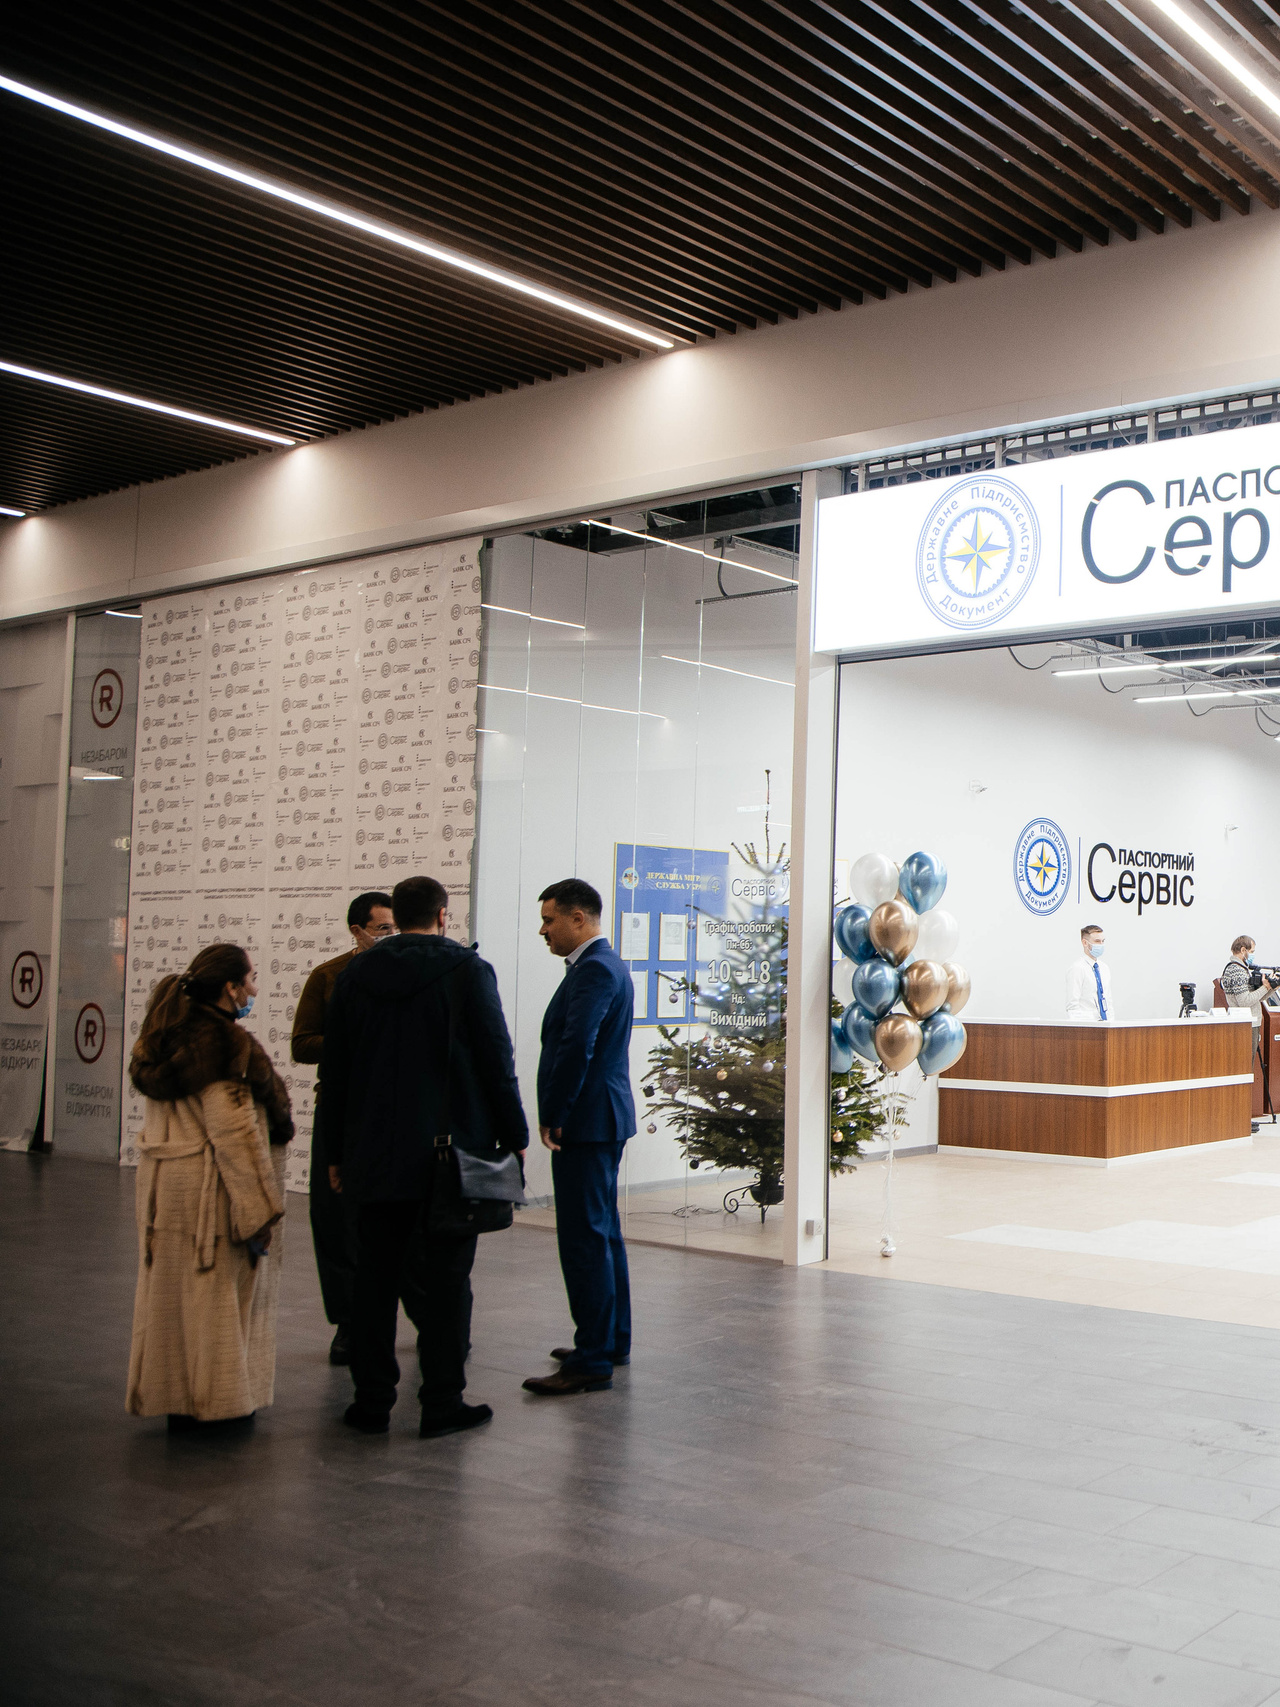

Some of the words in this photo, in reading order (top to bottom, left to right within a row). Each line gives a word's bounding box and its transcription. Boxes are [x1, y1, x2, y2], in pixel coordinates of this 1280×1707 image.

[970, 486, 1030, 574] Підприємство
[926, 500, 958, 584] Державне
[939, 588, 1010, 620] Документ
[1118, 848, 1194, 872] ПАСПОРТНИЙ
[656, 881, 684, 890] СЛУЖБА
[1088, 842, 1194, 916] Сервіс
[732, 878, 776, 899] Сервіс
[1025, 890, 1059, 908] Документ
[705, 921, 736, 934] Графік
[738, 920, 775, 934] роботи:
[726, 939, 753, 950] Пн-Сб:
[708, 960, 731, 983] 10
[748, 960, 771, 984] 18
[732, 994, 746, 1004] Нд:
[710, 1010, 767, 1027] Вихідний
[65, 1082, 113, 1099] НЕЗАБАРОМ
[66, 1101, 112, 1118] ВІДКРИТТЯ
